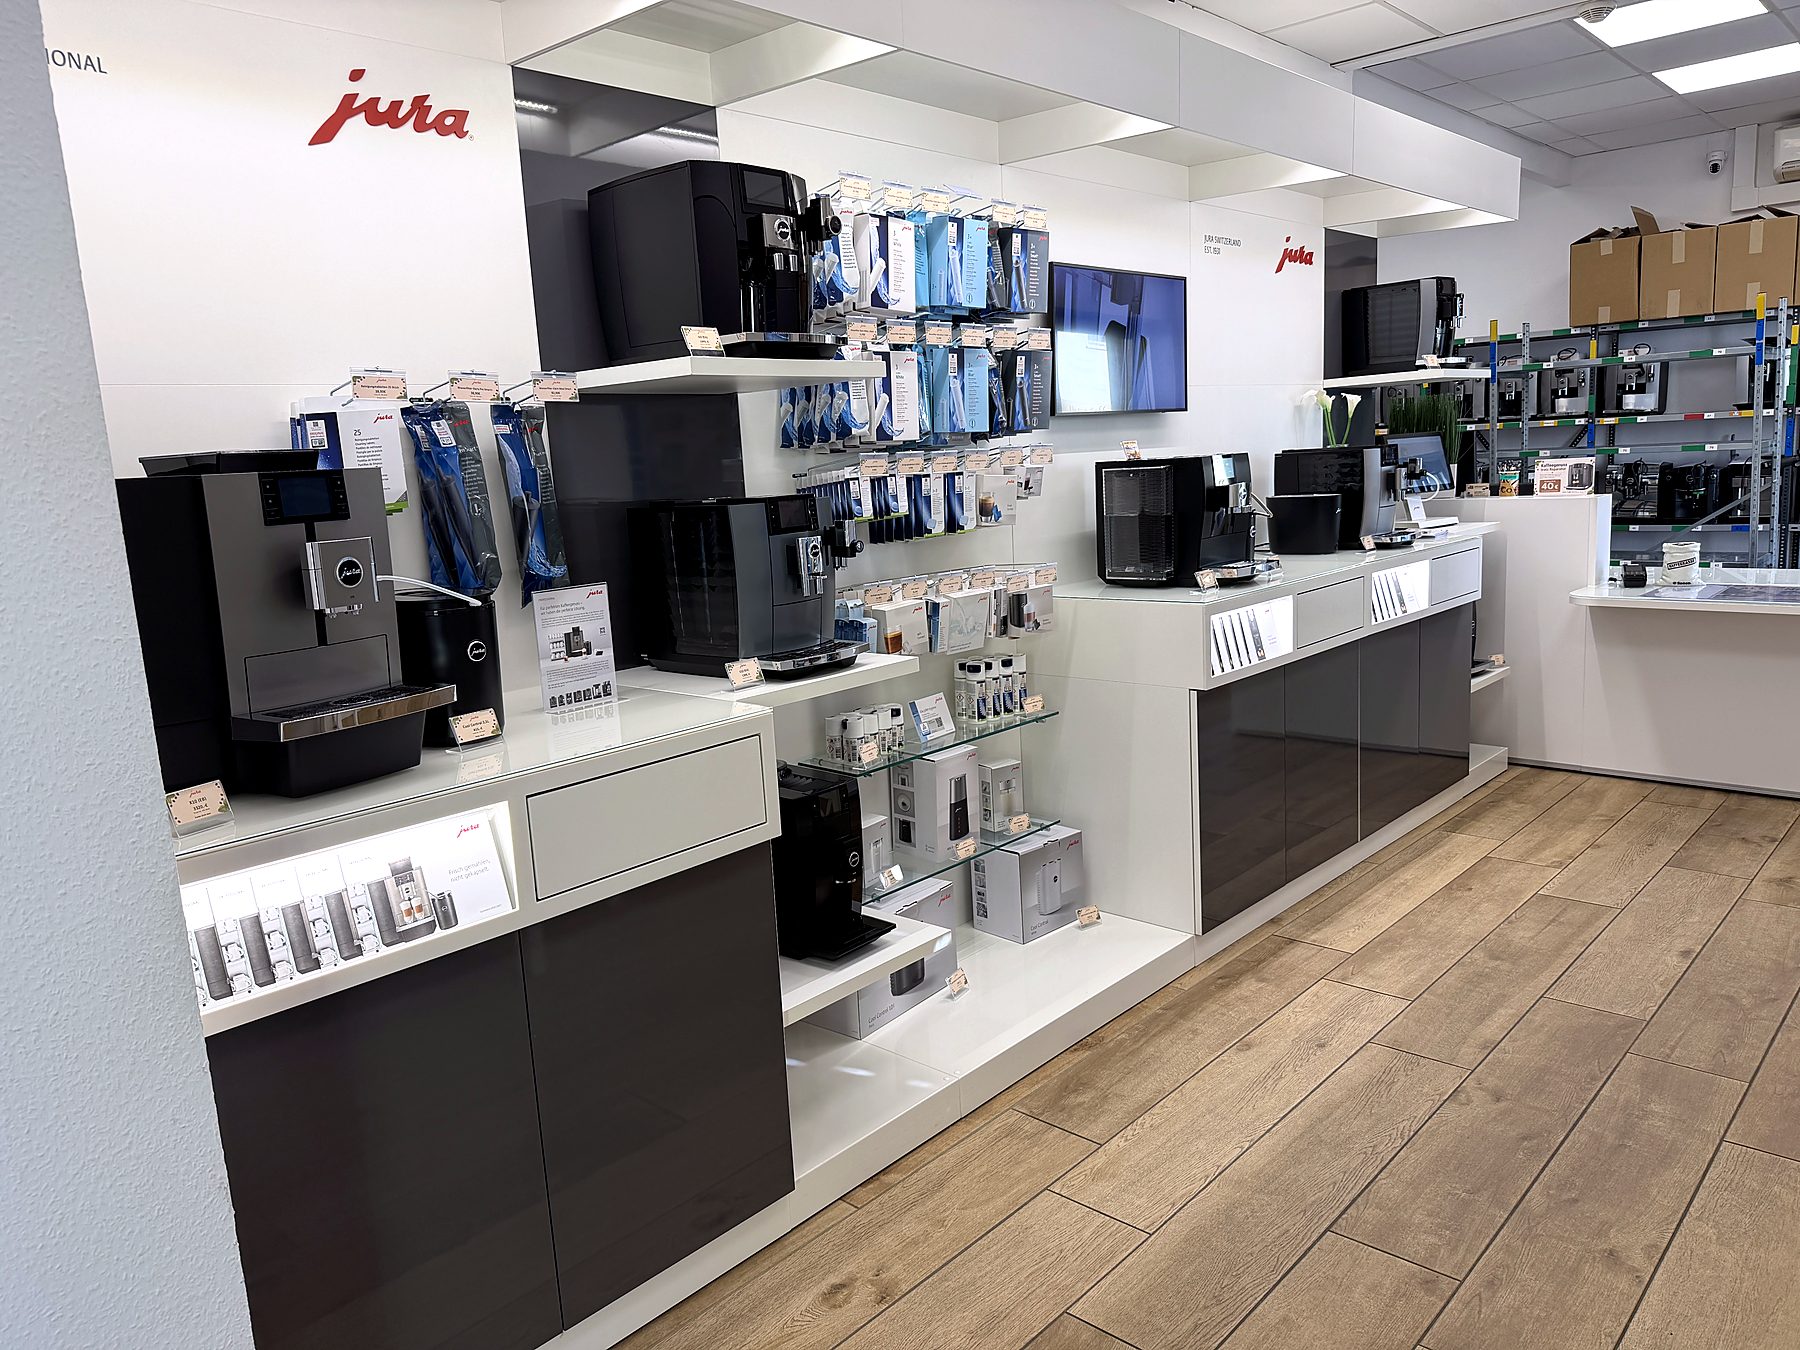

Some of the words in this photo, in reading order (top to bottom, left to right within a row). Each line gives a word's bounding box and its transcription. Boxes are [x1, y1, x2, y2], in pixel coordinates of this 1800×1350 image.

[45, 48, 107, 74] IONAL
[308, 69, 470, 146] jura
[1204, 235, 1214, 244] JURA
[1214, 236, 1241, 247] SWITZERLAND
[1275, 236, 1314, 273] jura
[373, 413, 393, 424] jura
[340, 567, 362, 580] jura
[586, 588, 603, 599] jura
[457, 824, 480, 838] jura
[938, 894, 951, 907] jura
